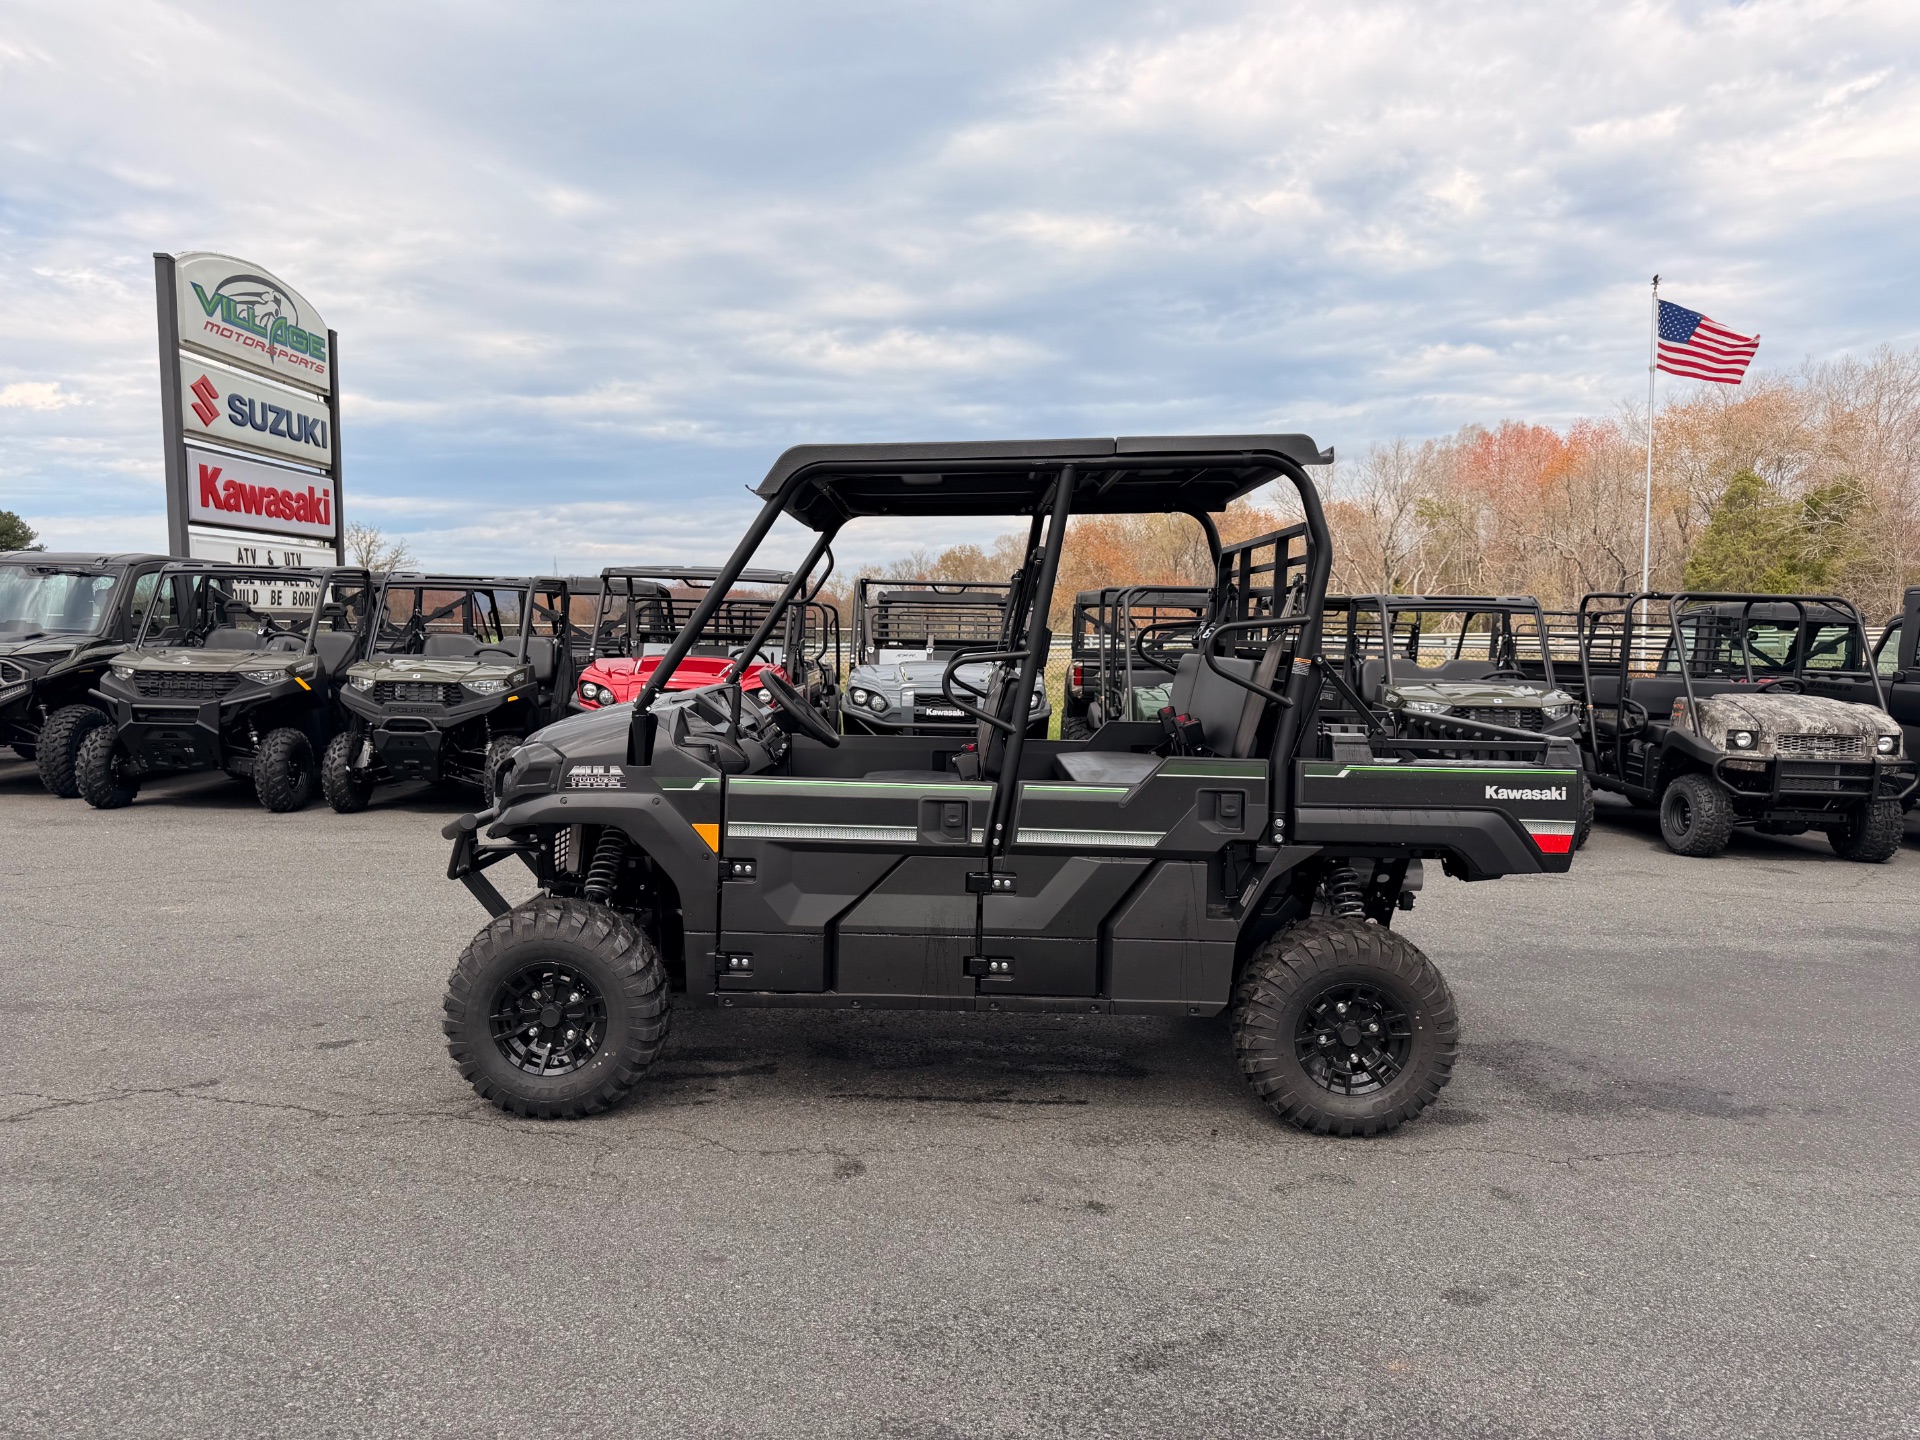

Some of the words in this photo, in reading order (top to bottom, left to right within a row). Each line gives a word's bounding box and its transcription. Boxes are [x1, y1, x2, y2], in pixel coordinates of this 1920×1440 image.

[190, 281, 326, 363] VILLAGE
[203, 321, 325, 374] MOTORSPORTS
[227, 393, 328, 449] SUZUKI
[198, 463, 331, 525] Kawasaki
[237, 547, 256, 564] ATV
[267, 550, 274, 566] &
[284, 552, 302, 566] UTV
[270, 590, 282, 606] BE
[149, 680, 213, 690] POLARIS
[388, 706, 438, 714] POLARIS
[926, 708, 964, 716] Kawasaki
[566, 765, 625, 777] MULE
[1485, 785, 1567, 800] Kawasaki
